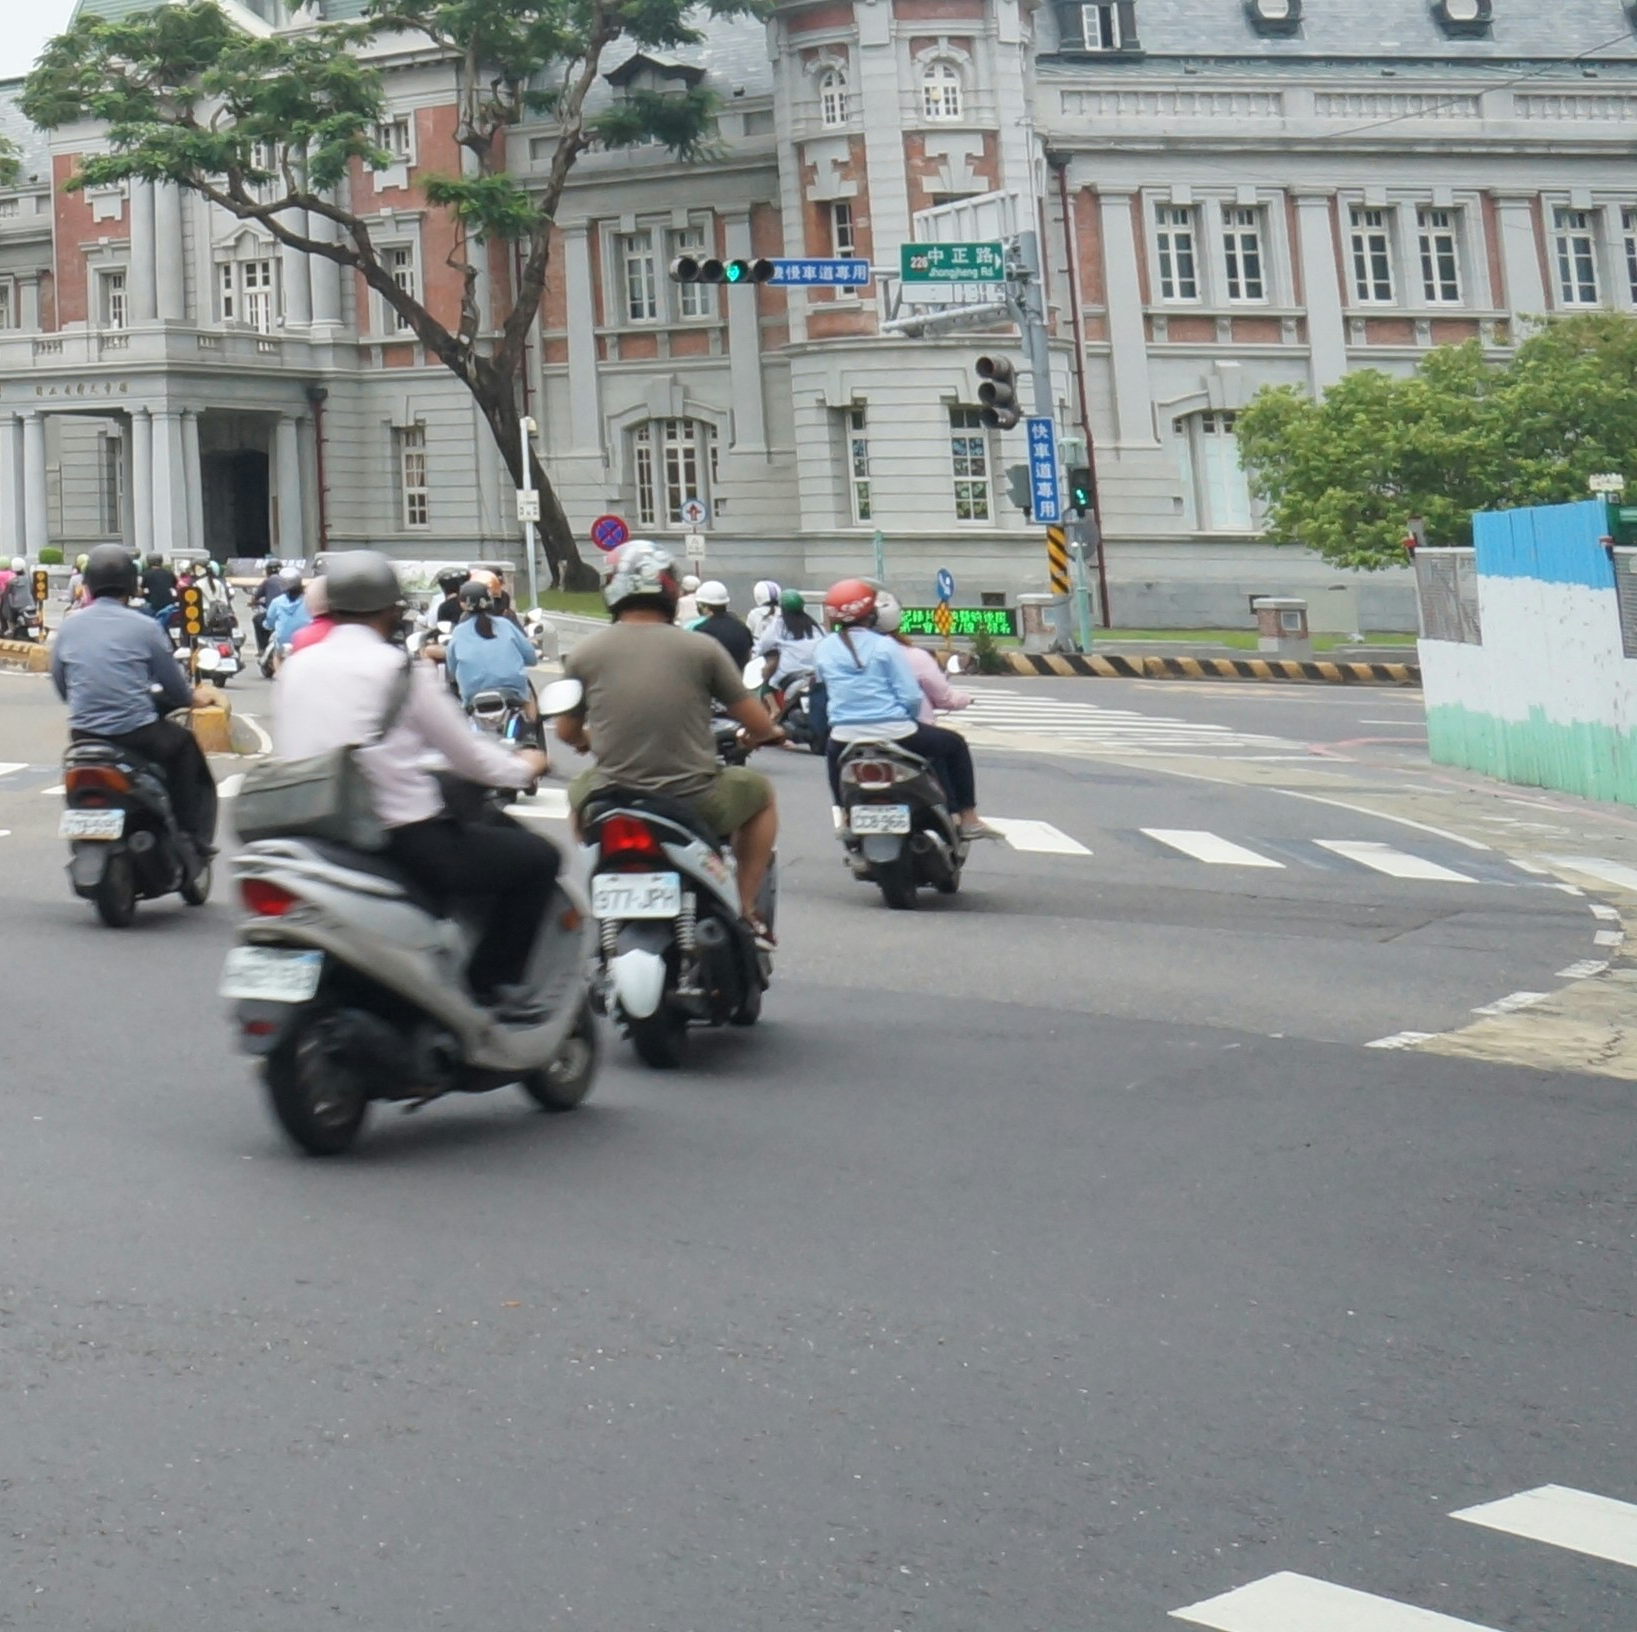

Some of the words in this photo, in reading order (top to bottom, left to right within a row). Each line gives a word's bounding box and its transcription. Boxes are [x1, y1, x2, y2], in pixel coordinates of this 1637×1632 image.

[927, 246, 994, 265] 中正路
[928, 267, 978, 280] Jhongjheng
[1031, 422, 1056, 518] 快車道專用
